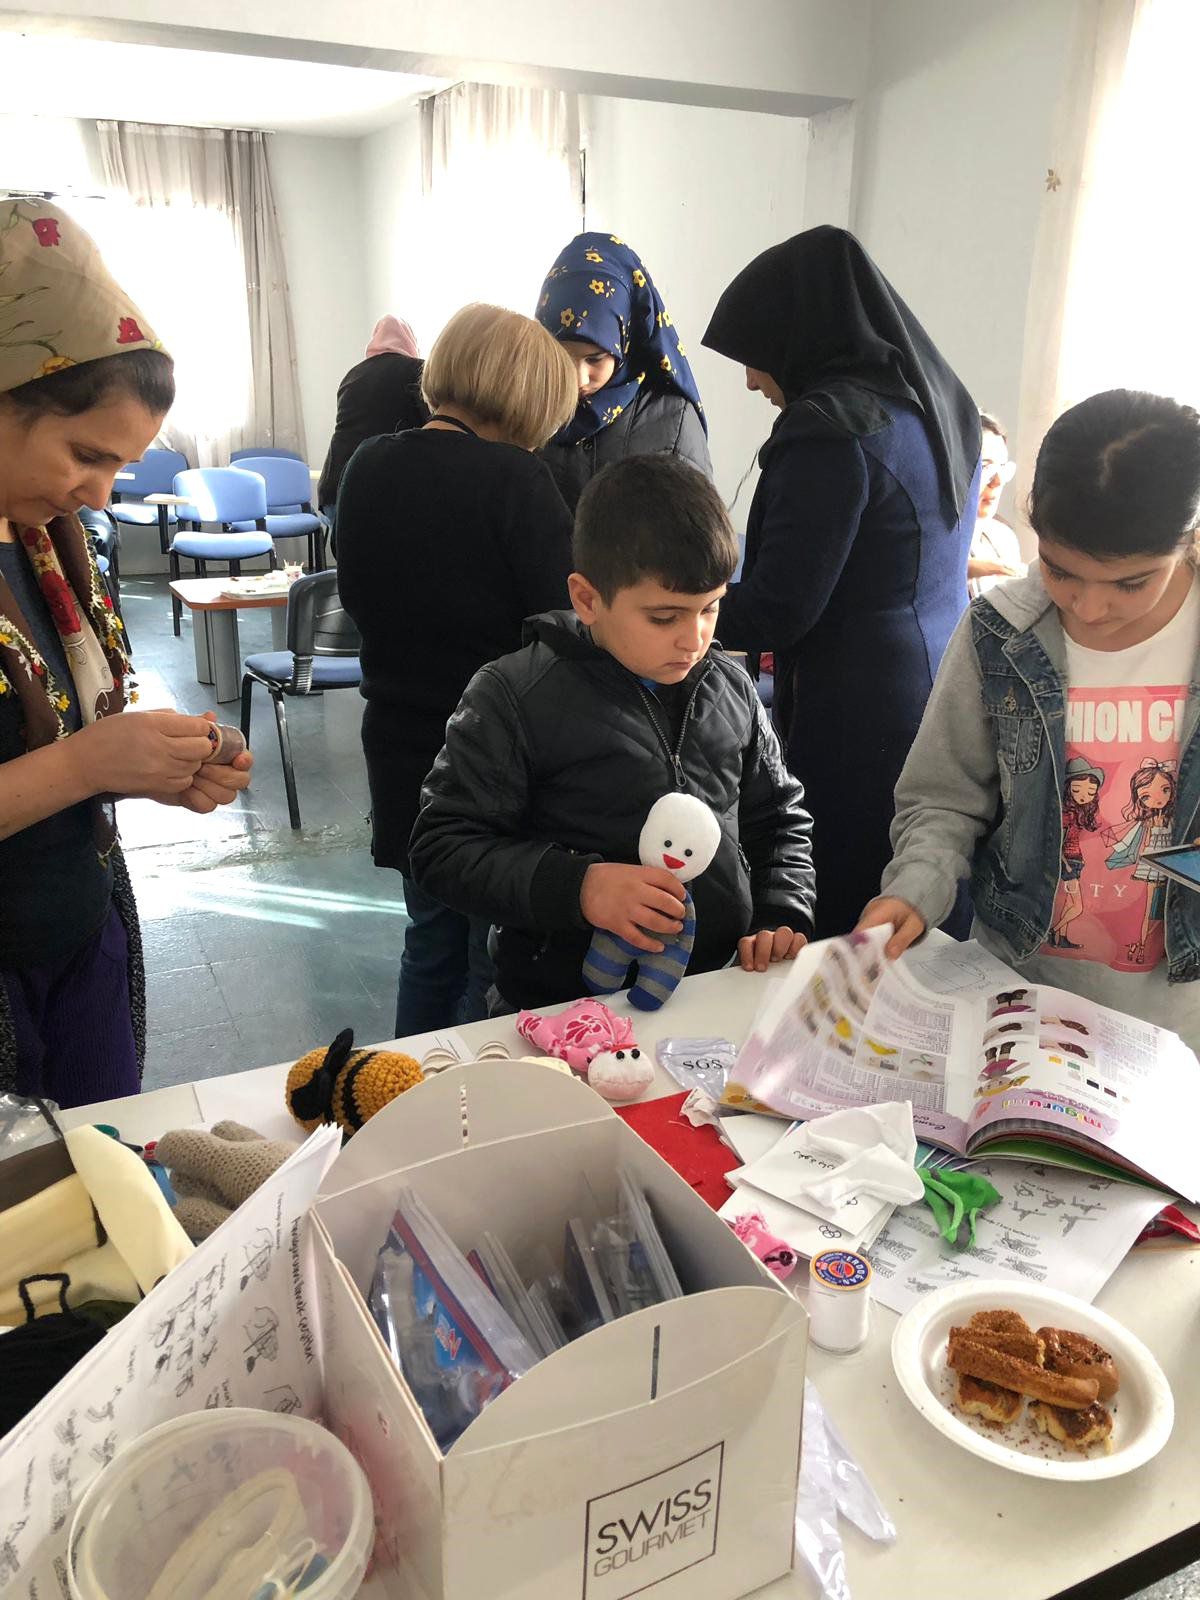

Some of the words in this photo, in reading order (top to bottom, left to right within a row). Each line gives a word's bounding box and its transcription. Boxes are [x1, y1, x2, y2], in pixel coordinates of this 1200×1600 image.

[1064, 701, 1142, 742] HION
[682, 1058, 723, 1071] SGS
[594, 1509, 711, 1577] GOURMET
[596, 1479, 711, 1555] SWISS
